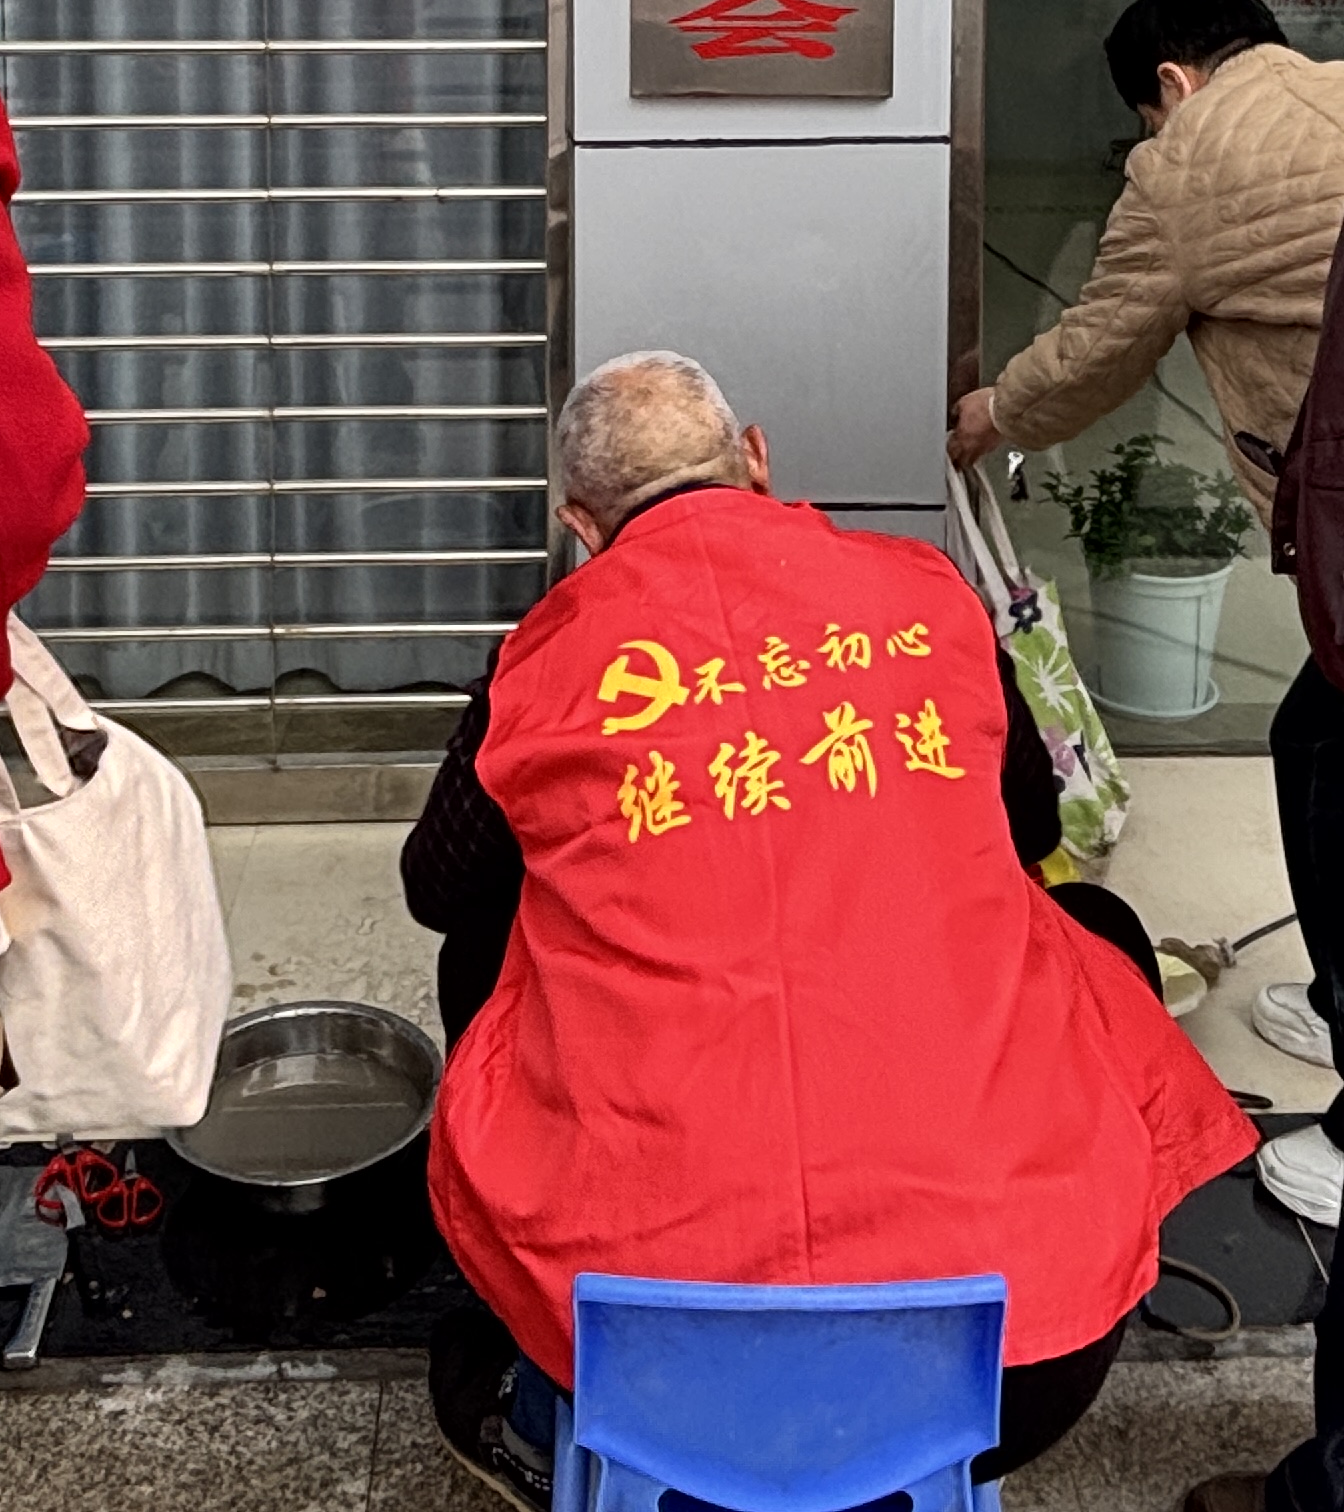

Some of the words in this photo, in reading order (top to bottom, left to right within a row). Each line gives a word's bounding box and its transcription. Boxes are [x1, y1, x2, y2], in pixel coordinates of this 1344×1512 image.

[693, 622, 933, 706] 不忘初心
[616, 698, 966, 844] 继续前进
